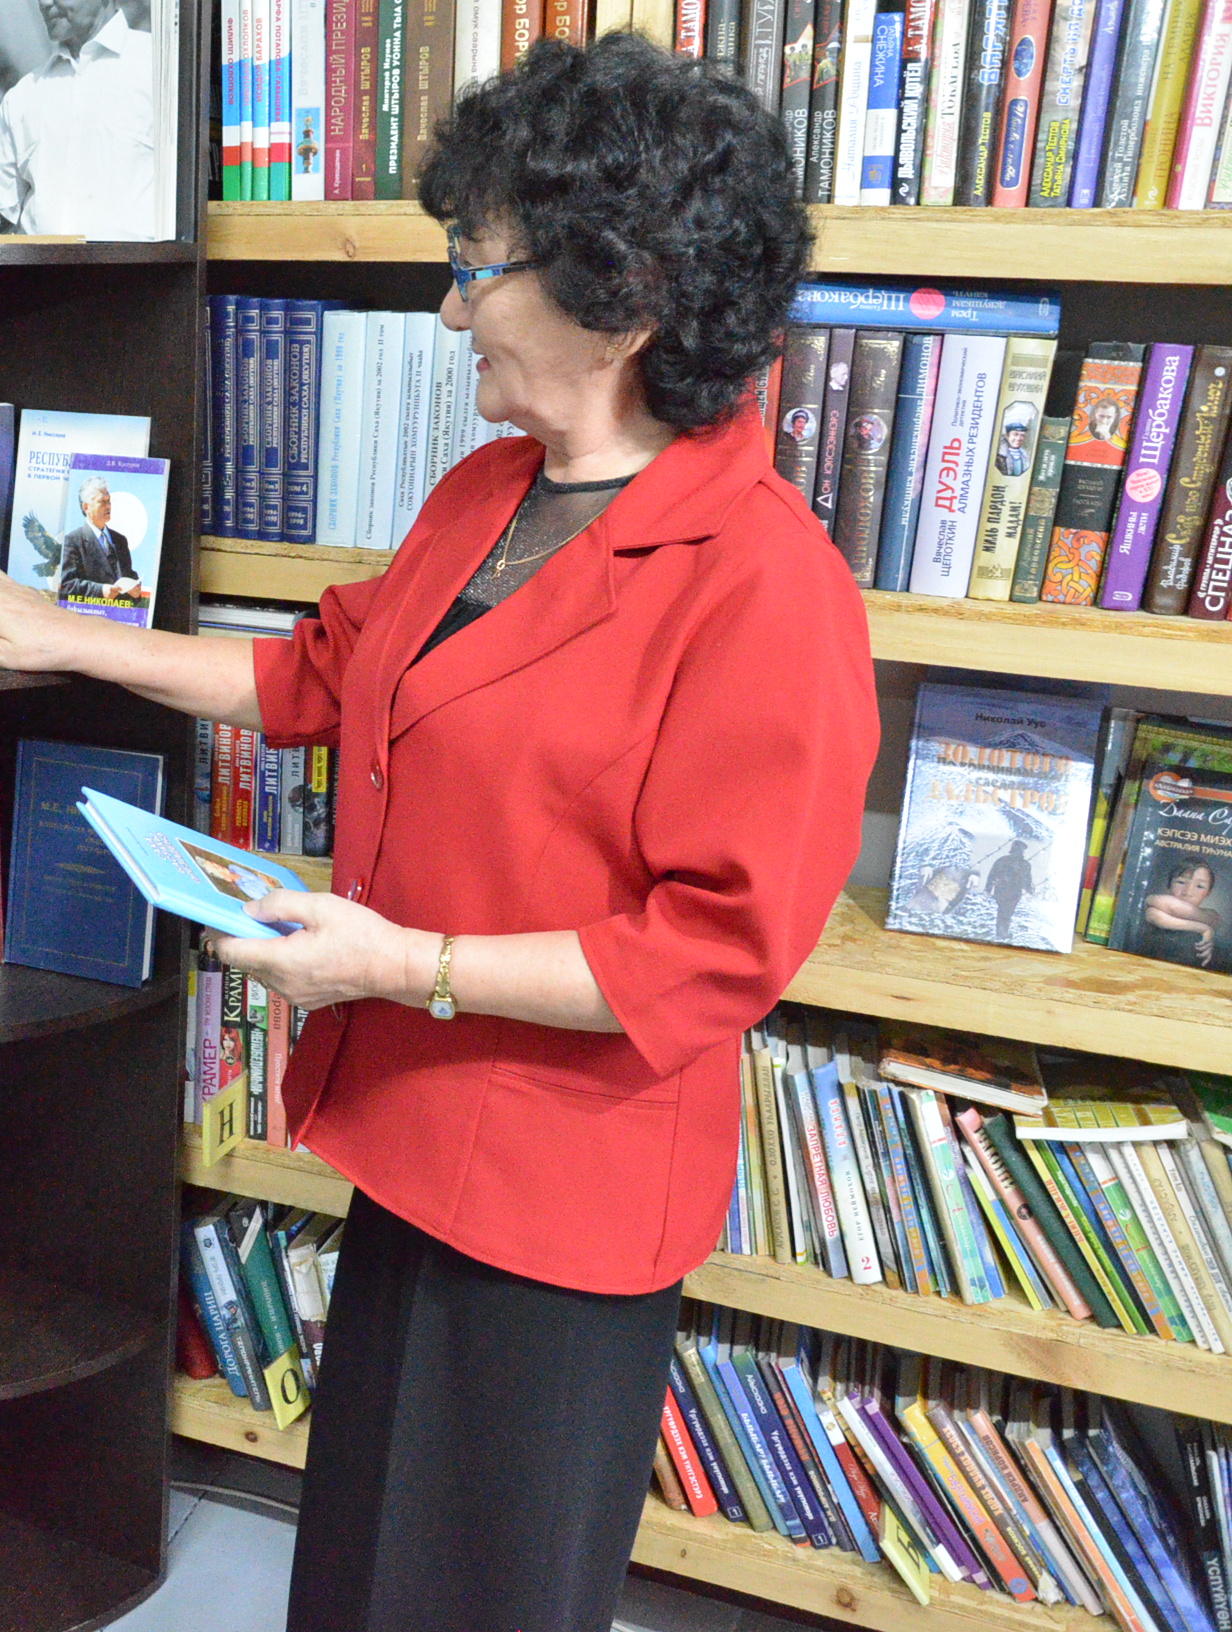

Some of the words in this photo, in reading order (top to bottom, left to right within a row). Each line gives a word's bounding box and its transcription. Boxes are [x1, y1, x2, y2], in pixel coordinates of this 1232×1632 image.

[393, 5, 402, 28] ТЫА
[254, 17, 262, 60] БАРАХОВ
[392, 30, 401, 66] УОННА
[873, 24, 887, 87] СНЕЖИНА
[886, 25, 895, 57] ТАТЬЯНА
[241, 62, 249, 105] НИКОЛАЙ
[254, 64, 263, 102] ИСИДОР
[360, 46, 370, 89] ШТЫРОВ
[418, 45, 429, 89] ШТЫРОВ
[902, 62, 923, 97] КОТЁЛ
[1057, 47, 1076, 106] СМЕРТЬ
[330, 54, 346, 134] НАРОДНЫЙ
[390, 68, 400, 114] ШТЫРОВ
[1122, 99, 1144, 162] Гиперболоид
[1135, 48, 1151, 95] инженера
[359, 95, 369, 139] Вячеслав
[417, 95, 427, 140] Вячеслав
[809, 111, 823, 162] Александр
[978, 111, 992, 144] ТЕСТОВ
[1046, 120, 1059, 150] ТЕСТОВ
[388, 116, 398, 173] ПРЕЗИДЕНТ
[815, 109, 839, 197] ТАМОНИКОВ
[894, 98, 921, 178] ДЬЯВОЛЬСКИЙ
[1055, 118, 1071, 163] СМИРНОВА
[1114, 118, 1129, 157] Толстой
[972, 145, 989, 195] АЛЕКСАНДР
[1039, 151, 1055, 197] АЛЕКСАНДР
[1050, 162, 1064, 196] ТАТЬЯНА
[797, 289, 904, 310] Щербакова
[950, 310, 977, 320] Трем
[952, 299, 1005, 307] девушкам
[288, 344, 300, 402] ЗАКОНОВ
[300, 343, 312, 382] (ЯКУТИЯ)
[375, 361, 383, 375] 2002
[445, 366, 454, 385] 2000
[448, 350, 457, 364] год
[915, 335, 933, 395] ЛИМОНОВ
[241, 358, 249, 398] ЗАКОНОВ
[264, 359, 274, 401] ЗАКОНОВ
[301, 384, 310, 407] САХА
[446, 389, 453, 397] за
[950, 346, 969, 426] Политико-экономический
[373, 387, 383, 418] (Якутия)
[431, 380, 443, 431] ЗАКОНОВ
[441, 400, 454, 439] (Якутия)
[957, 399, 967, 426] детектив
[1139, 355, 1180, 465] Щербакова
[240, 401, 249, 445] СБОРНИК
[263, 403, 273, 447] СБОРНИК
[286, 404, 299, 462] СБОРНИК
[299, 409, 310, 462] РЕСПУБЛИКИ
[372, 419, 380, 437] Саха
[459, 428, 467, 446] 1999
[905, 398, 925, 472] американские
[955, 446, 976, 513] АЛМАЗНЫХ
[966, 371, 987, 444] РЕЗИДЕНТОВ
[28, 465, 65, 474] СТРАТЕГИЯ
[369, 438, 380, 479] Республики
[427, 434, 440, 485] СБОРНИК
[440, 441, 450, 463] Саха
[33, 473, 60, 481] ПЕРВОЙ
[300, 483, 307, 492] 4
[329, 464, 339, 494] ЗАКОНОВ
[404, 449, 417, 510] СОКУОННАРЫН
[933, 435, 966, 512] ДУЭЛЬ
[328, 498, 337, 529] СБОРНИК
[855, 466, 876, 567] ШОЛОХОВ
[899, 475, 915, 525] каникулы
[1005, 499, 1022, 539] МАДАМ!
[1186, 489, 1201, 511] про
[365, 510, 374, 539] Сборник
[932, 518, 948, 563] Вячеслав
[982, 520, 998, 554] МИЛЬ
[1119, 511, 1138, 555] Яшкины
[1139, 512, 1150, 536] дети
[939, 519, 959, 577] ЩЕПОТКИН
[1162, 545, 1184, 589] Владимир
[975, 712, 1025, 727] Николай
[1027, 717, 1046, 729] Уус
[937, 742, 1073, 774] ЗОЛОТОГО
[1154, 840, 1201, 853] АВСТРАЛИЯ
[1157, 827, 1199, 841] КЭПСЭЭ
[273, 1053, 282, 1083] Простите
[827, 1097, 848, 1147] АЛАМПА
[766, 1128, 777, 1165] ОЛОХХО
[804, 1125, 828, 1186] ЗАПРЕТНАЯ
[818, 1191, 838, 1238] ЛЮБОВЬ
[843, 1169, 859, 1217] НЕЙМОХОВ
[854, 1219, 864, 1241] ЕГОР
[859, 1255, 873, 1272] 2
[203, 1290, 225, 1331] ЦАРИЦ
[216, 1331, 240, 1379] ДОРОГА
[235, 1334, 261, 1403] ТЕЛОХРАНИТЕЛЬ
[677, 1445, 689, 1460] КЭМ
[940, 1423, 965, 1454] БЭЛЭХ
[980, 1432, 1010, 1471] БОРИСОВ
[979, 1486, 1003, 1516] ХАРАХ
[1003, 1469, 1030, 1504] АНДРЕЙ
[1004, 1524, 1027, 1556] БОСИКОВ
